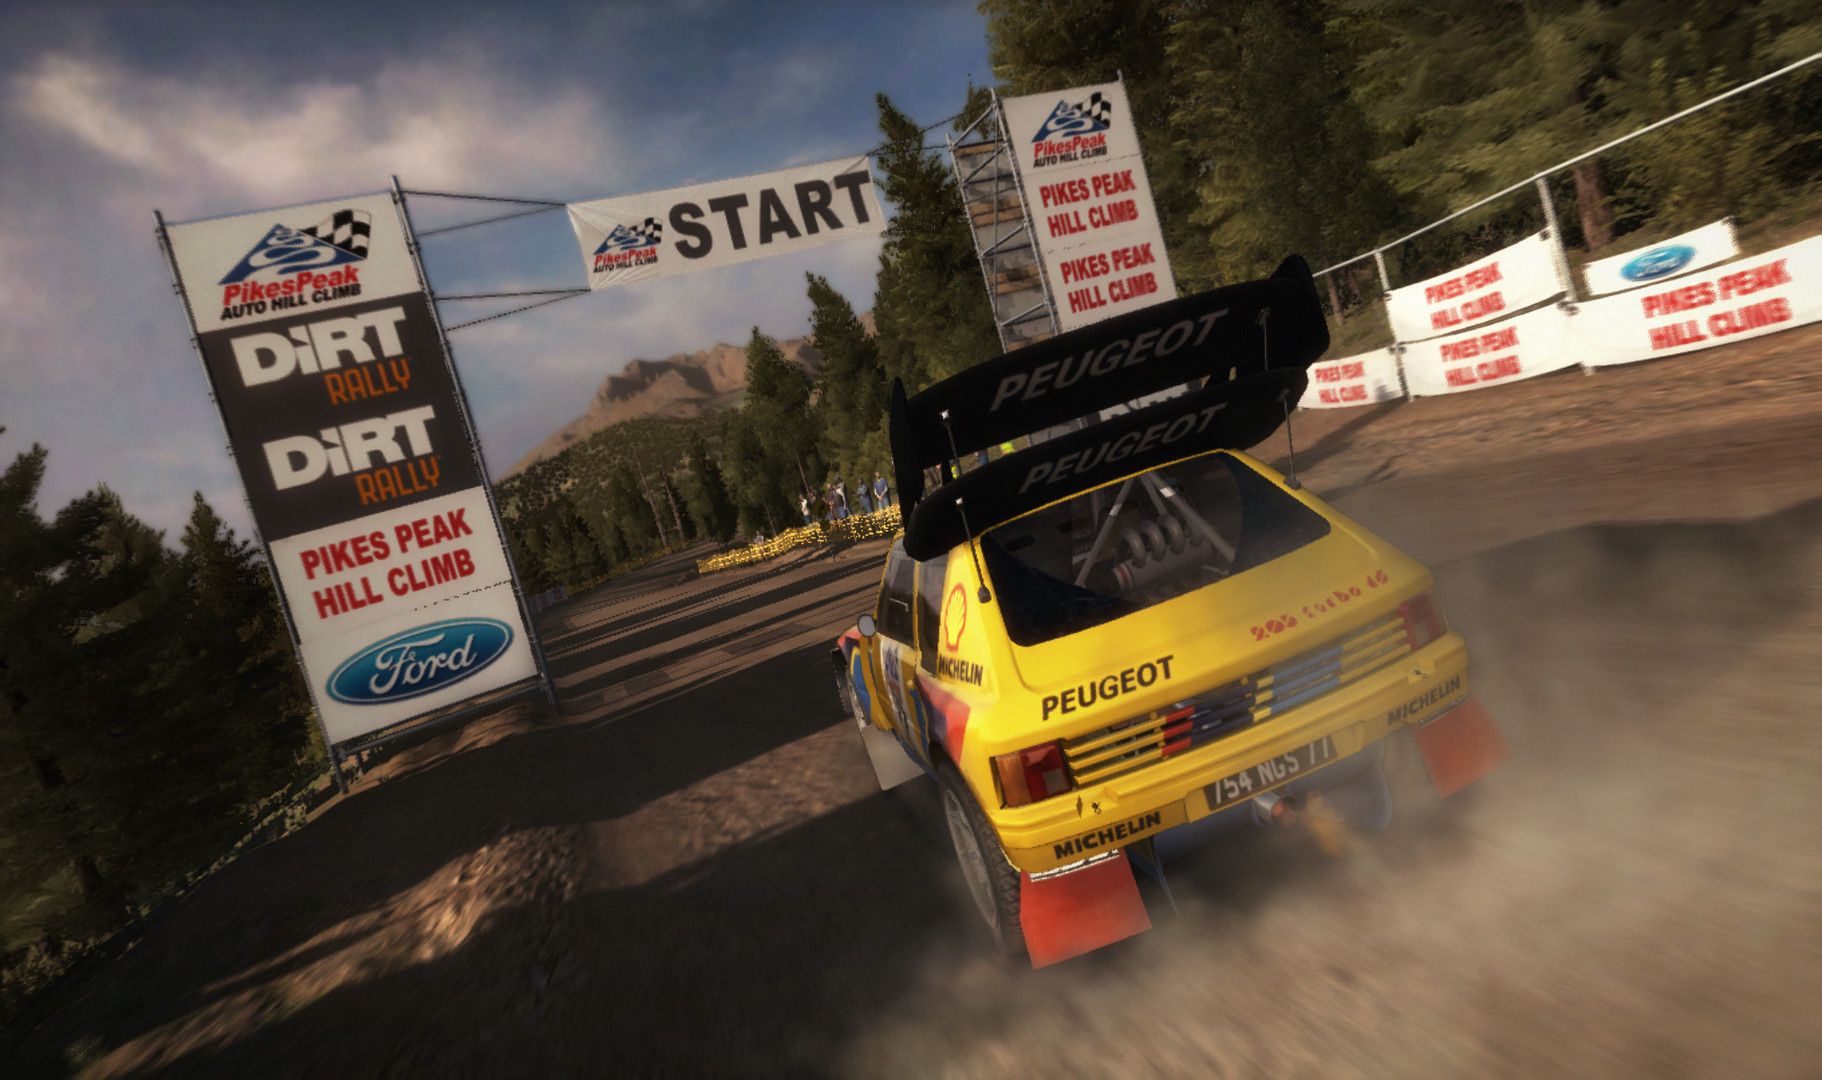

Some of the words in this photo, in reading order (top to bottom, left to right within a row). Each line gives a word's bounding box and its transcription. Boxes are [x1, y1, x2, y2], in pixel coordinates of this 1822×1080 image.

[1033, 156, 1058, 168] AUTO
[1034, 132, 1106, 159] PikesPeak
[1040, 178, 1090, 208] PIKES
[1091, 169, 1136, 199] PEAK
[668, 170, 871, 260] START
[1047, 210, 1087, 238] HILL
[1088, 199, 1138, 230] CLIMB
[223, 264, 359, 306] PikesPeak
[1060, 253, 1110, 284] PIKES
[1111, 242, 1156, 272] PEAK
[220, 301, 267, 320] AUTO
[271, 293, 308, 311] HILL
[311, 283, 362, 303] CLIMB
[1067, 286, 1107, 313] HILL
[1108, 272, 1158, 302] CLIMB
[323, 360, 412, 406] RALLY
[989, 308, 1230, 413] PEUGEOT
[1019, 403, 1228, 495] PEUGEOT
[354, 456, 441, 506] RALLY
[299, 531, 391, 580] PIKES
[394, 508, 473, 553] PEAK
[311, 576, 384, 620] HILL
[387, 548, 476, 597] CLIMB
[368, 632, 478, 696] Ford
[938, 655, 984, 687] MICHELIN
[1042, 655, 1174, 721] PEUGEOT
[1388, 672, 1460, 726] MICHELIN
[1054, 810, 1161, 860] MICHELIN
